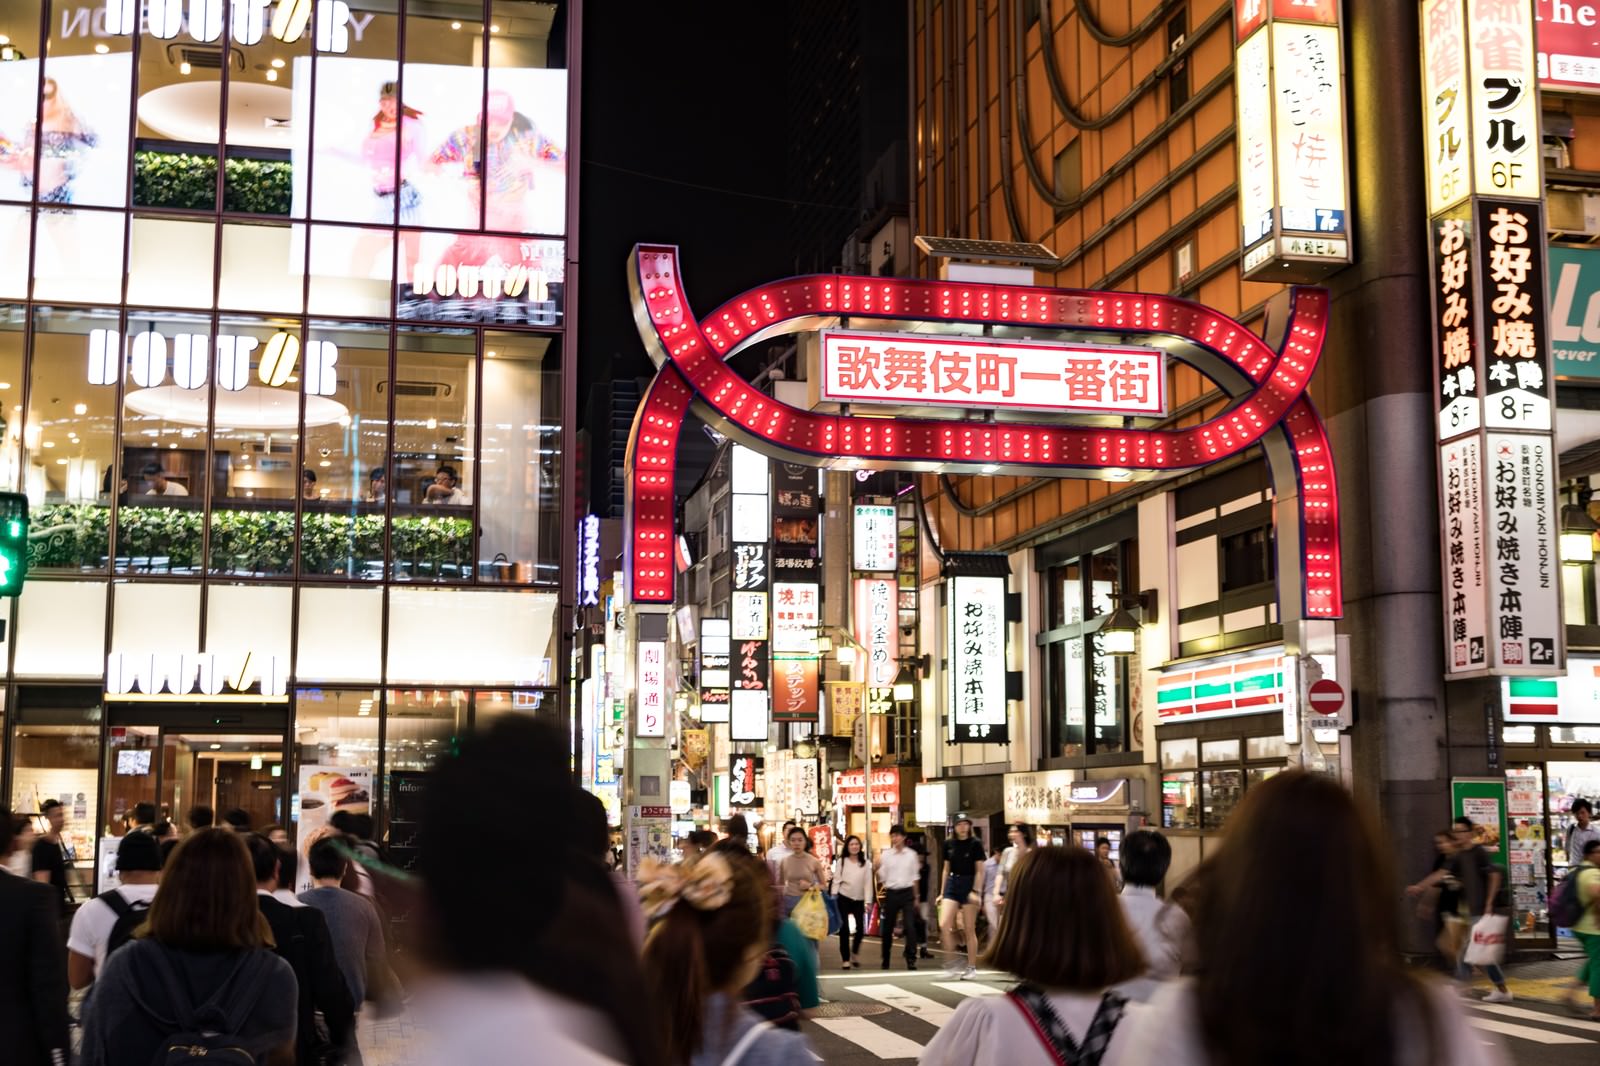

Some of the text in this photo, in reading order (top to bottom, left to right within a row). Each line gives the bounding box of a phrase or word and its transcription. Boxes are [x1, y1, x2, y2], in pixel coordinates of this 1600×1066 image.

[1536, 0, 1597, 26] he
[1492, 162, 1522, 189] 6F
[1317, 210, 1340, 231] 7F
[1440, 219, 1471, 369] お好み焼
[1489, 208, 1537, 358] お好み焼
[88, 328, 338, 396] DOUTOR
[837, 346, 1150, 403] 歌舞伎町一番街
[1489, 360, 1544, 389] 本陣
[1501, 396, 1534, 420] 8F
[1533, 445, 1550, 588] OKONOMIYAKI HONJIN
[1448, 467, 1467, 642] お好み焼き本陣
[1495, 460, 1523, 640] お好み焼き本陣
[1471, 641, 1484, 660] 2F
[1531, 641, 1553, 660] 2F
[644, 649, 659, 727] 劇場通り
[785, 662, 807, 711] ステップ
